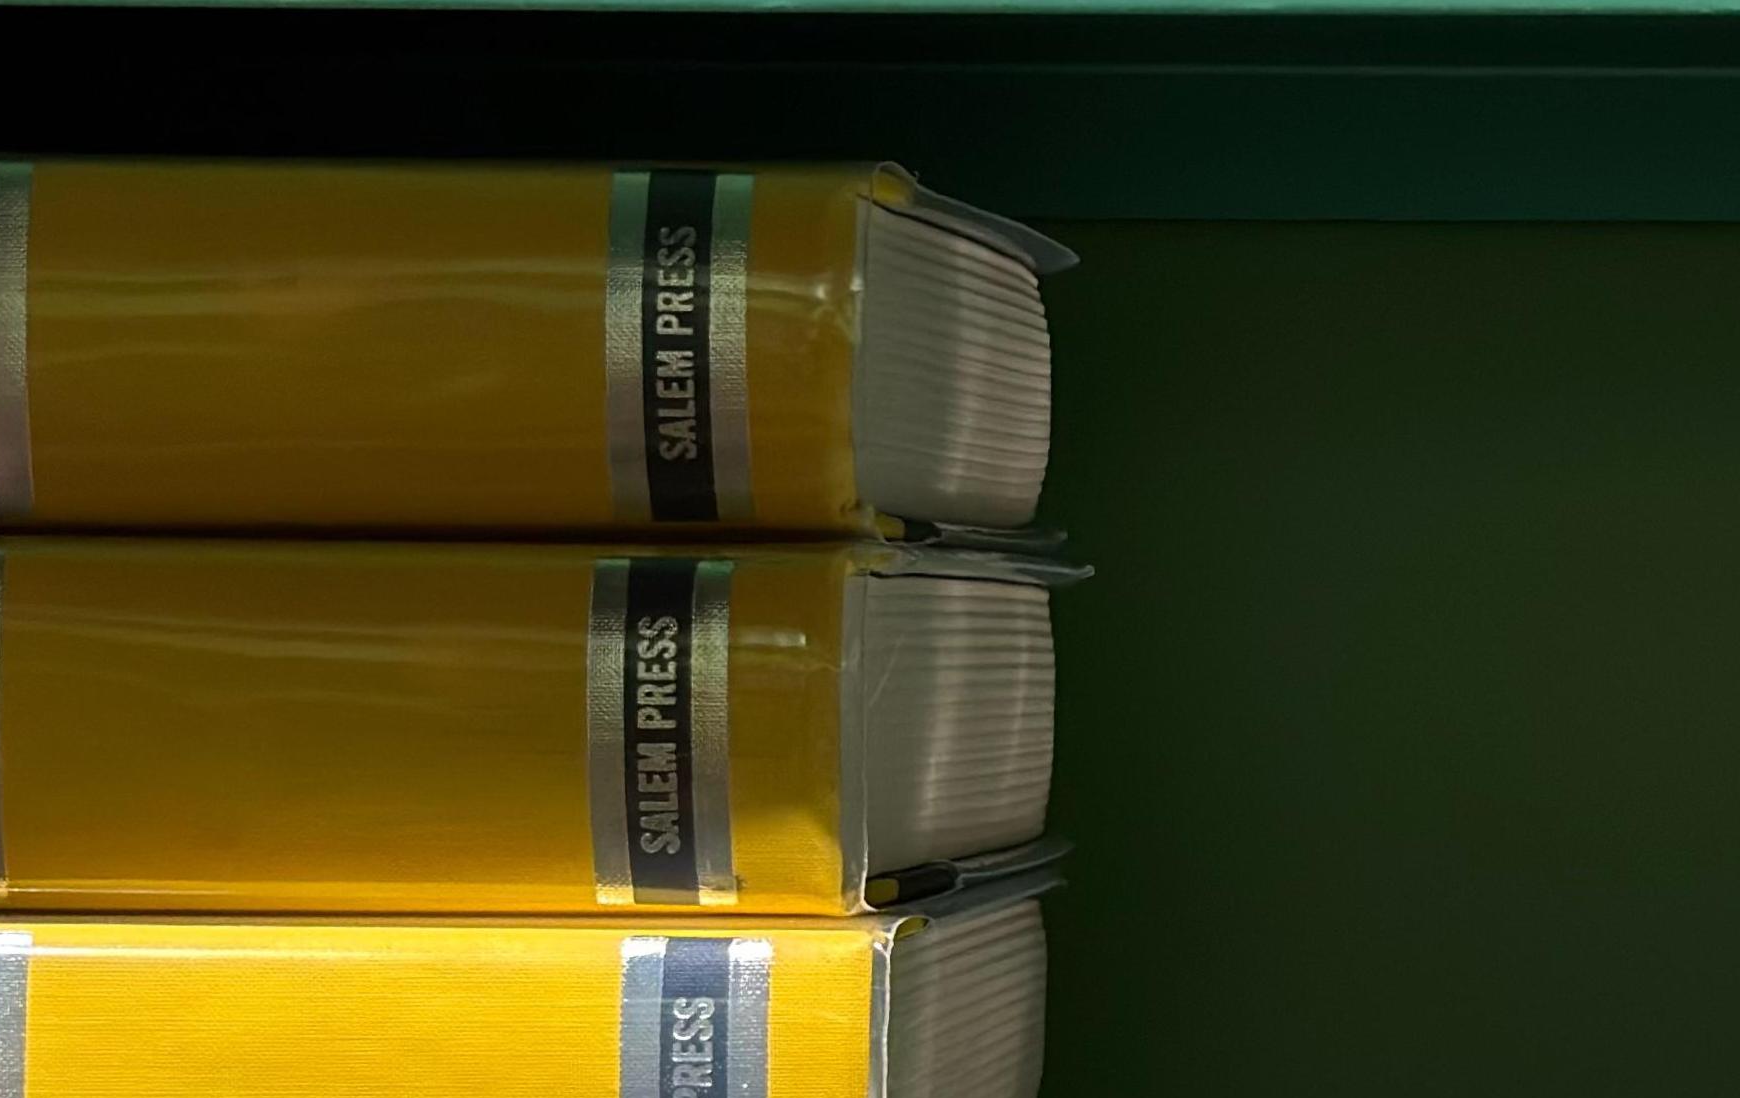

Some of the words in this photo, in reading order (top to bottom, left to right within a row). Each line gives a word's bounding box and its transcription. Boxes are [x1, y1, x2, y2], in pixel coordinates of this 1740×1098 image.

[657, 225, 698, 336] PRESS
[658, 349, 698, 461] SALEM
[637, 616, 678, 729] PRESS
[638, 742, 680, 855] SALEM
